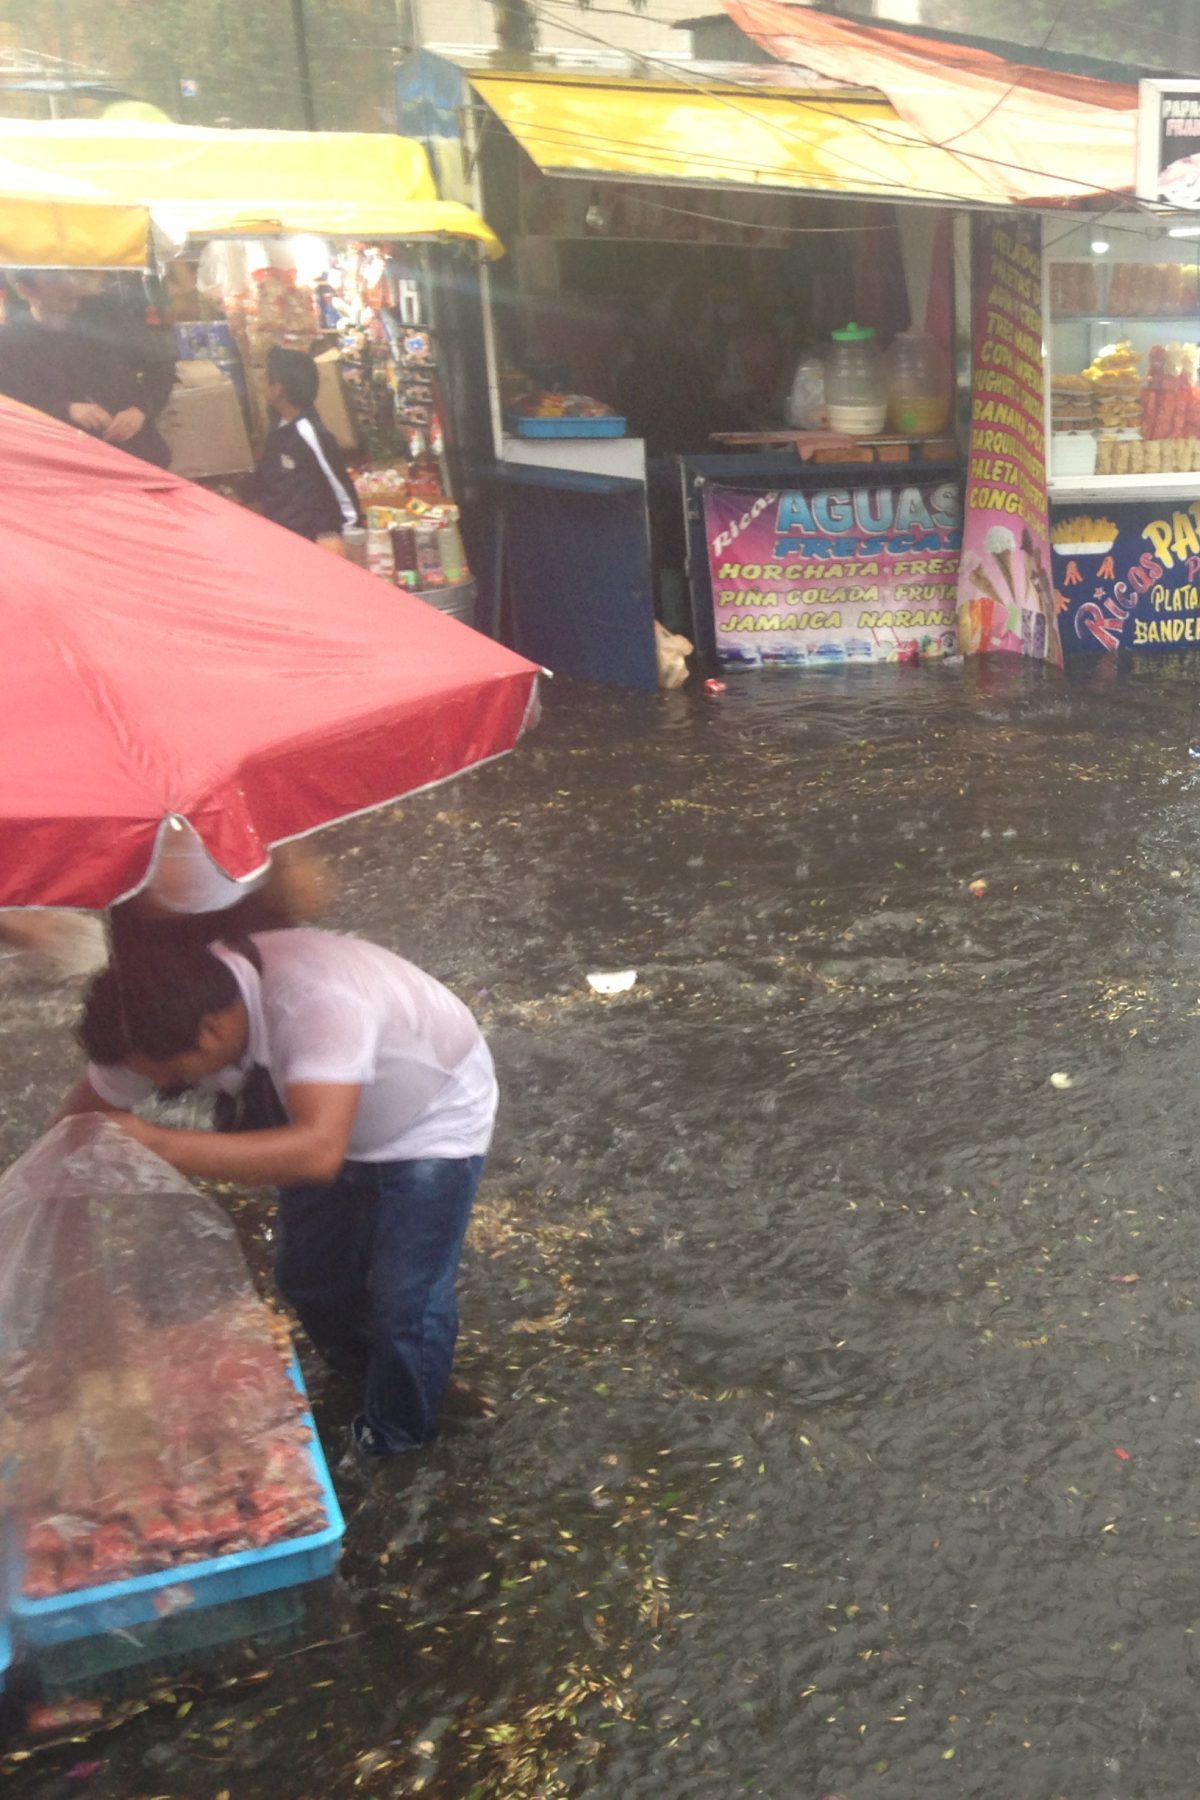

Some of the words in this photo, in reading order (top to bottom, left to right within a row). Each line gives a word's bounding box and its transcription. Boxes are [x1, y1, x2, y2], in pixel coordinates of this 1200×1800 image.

[775, 482, 964, 536] AGUAS
[772, 531, 962, 561] FRESCAS
[718, 561, 880, 580] HORCHATA
[718, 586, 779, 607] PIÑA
[785, 585, 881, 605] COLADA
[719, 611, 843, 633] JAMAICA
